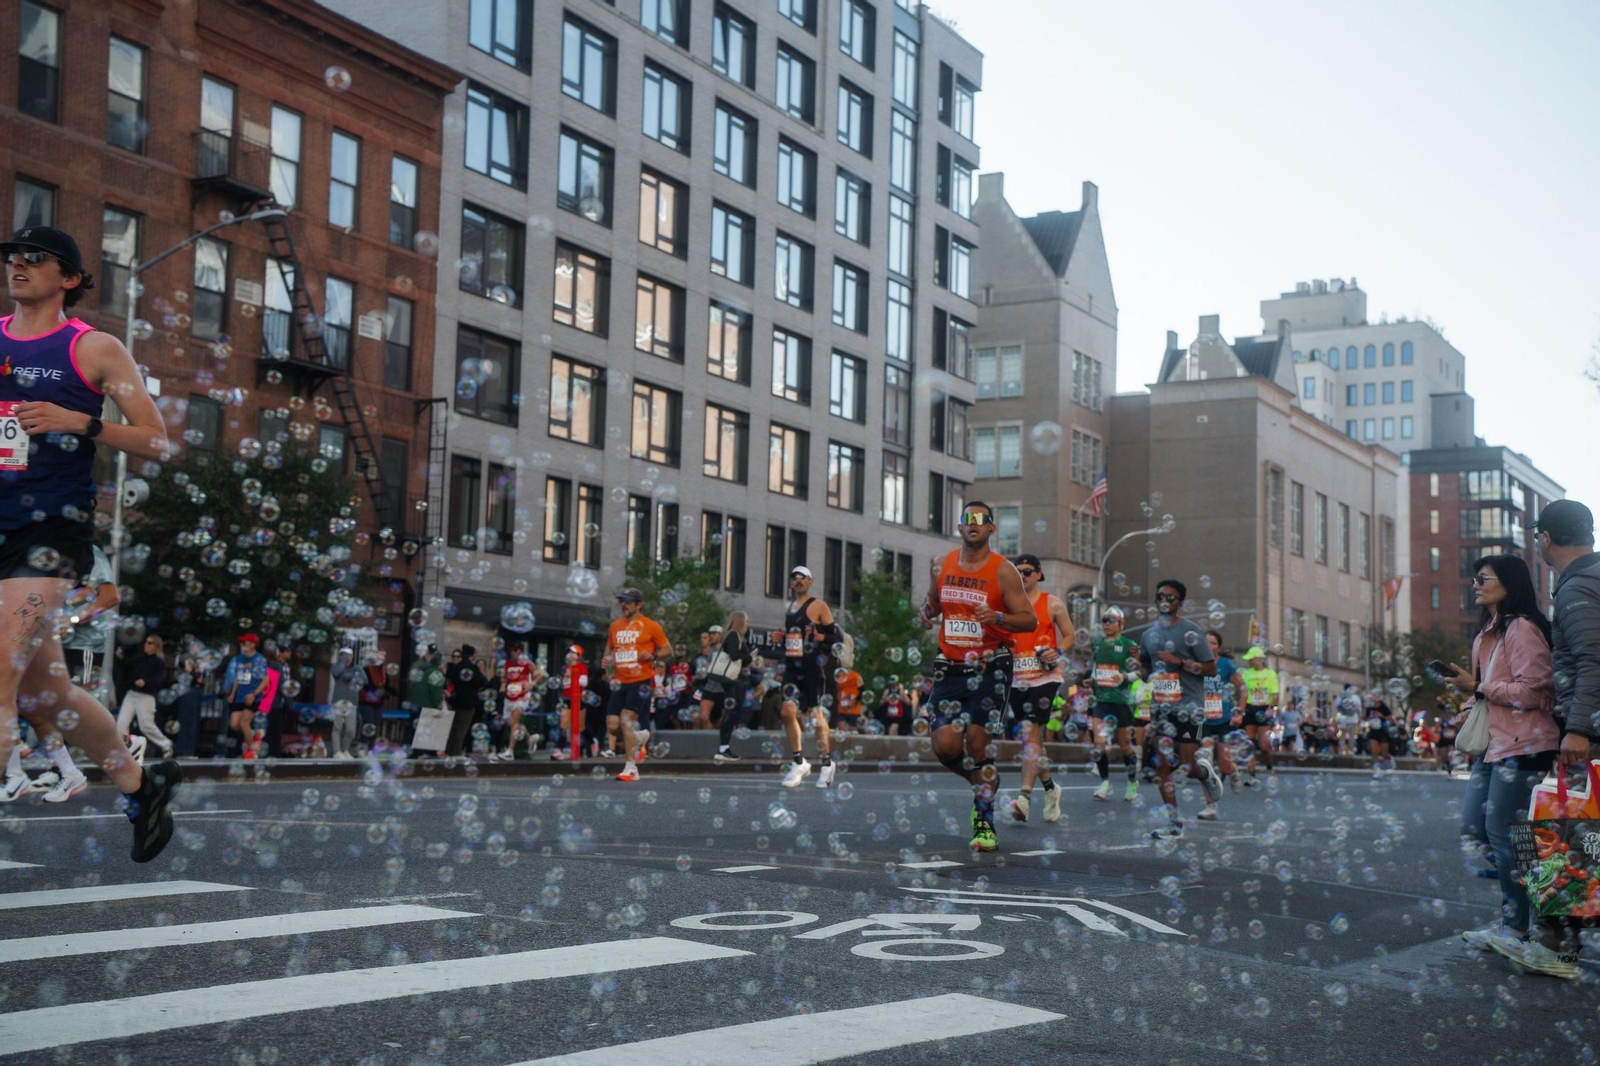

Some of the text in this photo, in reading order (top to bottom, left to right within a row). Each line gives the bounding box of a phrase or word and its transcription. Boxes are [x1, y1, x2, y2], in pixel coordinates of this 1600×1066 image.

[13, 366, 62, 380] REEVE
[945, 575, 988, 591] ALBERT
[942, 590, 985, 602] FRED'S TEAM
[948, 620, 978, 634] 12710
[617, 636, 637, 645] TEAM
[1556, 954, 1578, 964] HOKA
